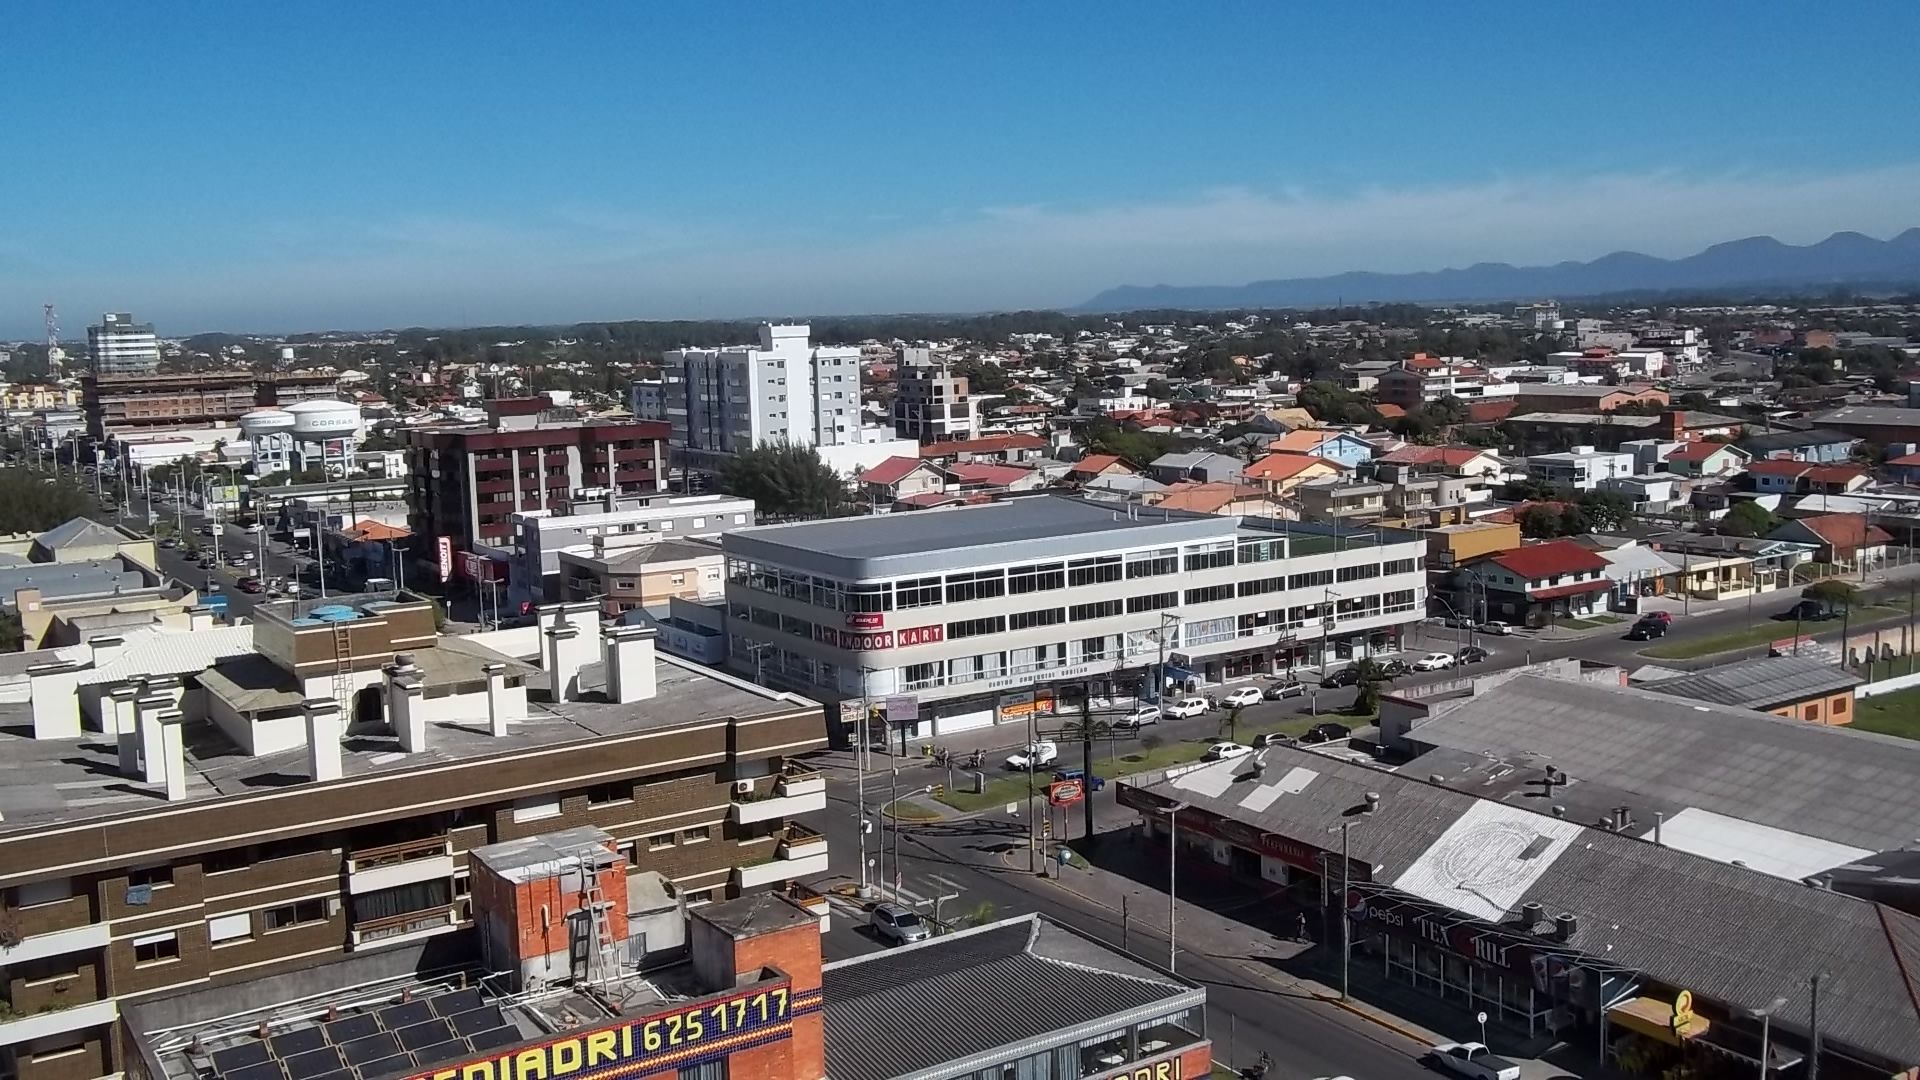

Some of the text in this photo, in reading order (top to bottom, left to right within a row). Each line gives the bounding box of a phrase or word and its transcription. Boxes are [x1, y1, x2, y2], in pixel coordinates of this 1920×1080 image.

[840, 633, 893, 650] INDOOR
[899, 628, 940, 645] KART
[1369, 906, 1404, 928] pepsi
[643, 1009, 703, 1051] 625
[710, 988, 787, 1032] 1717
